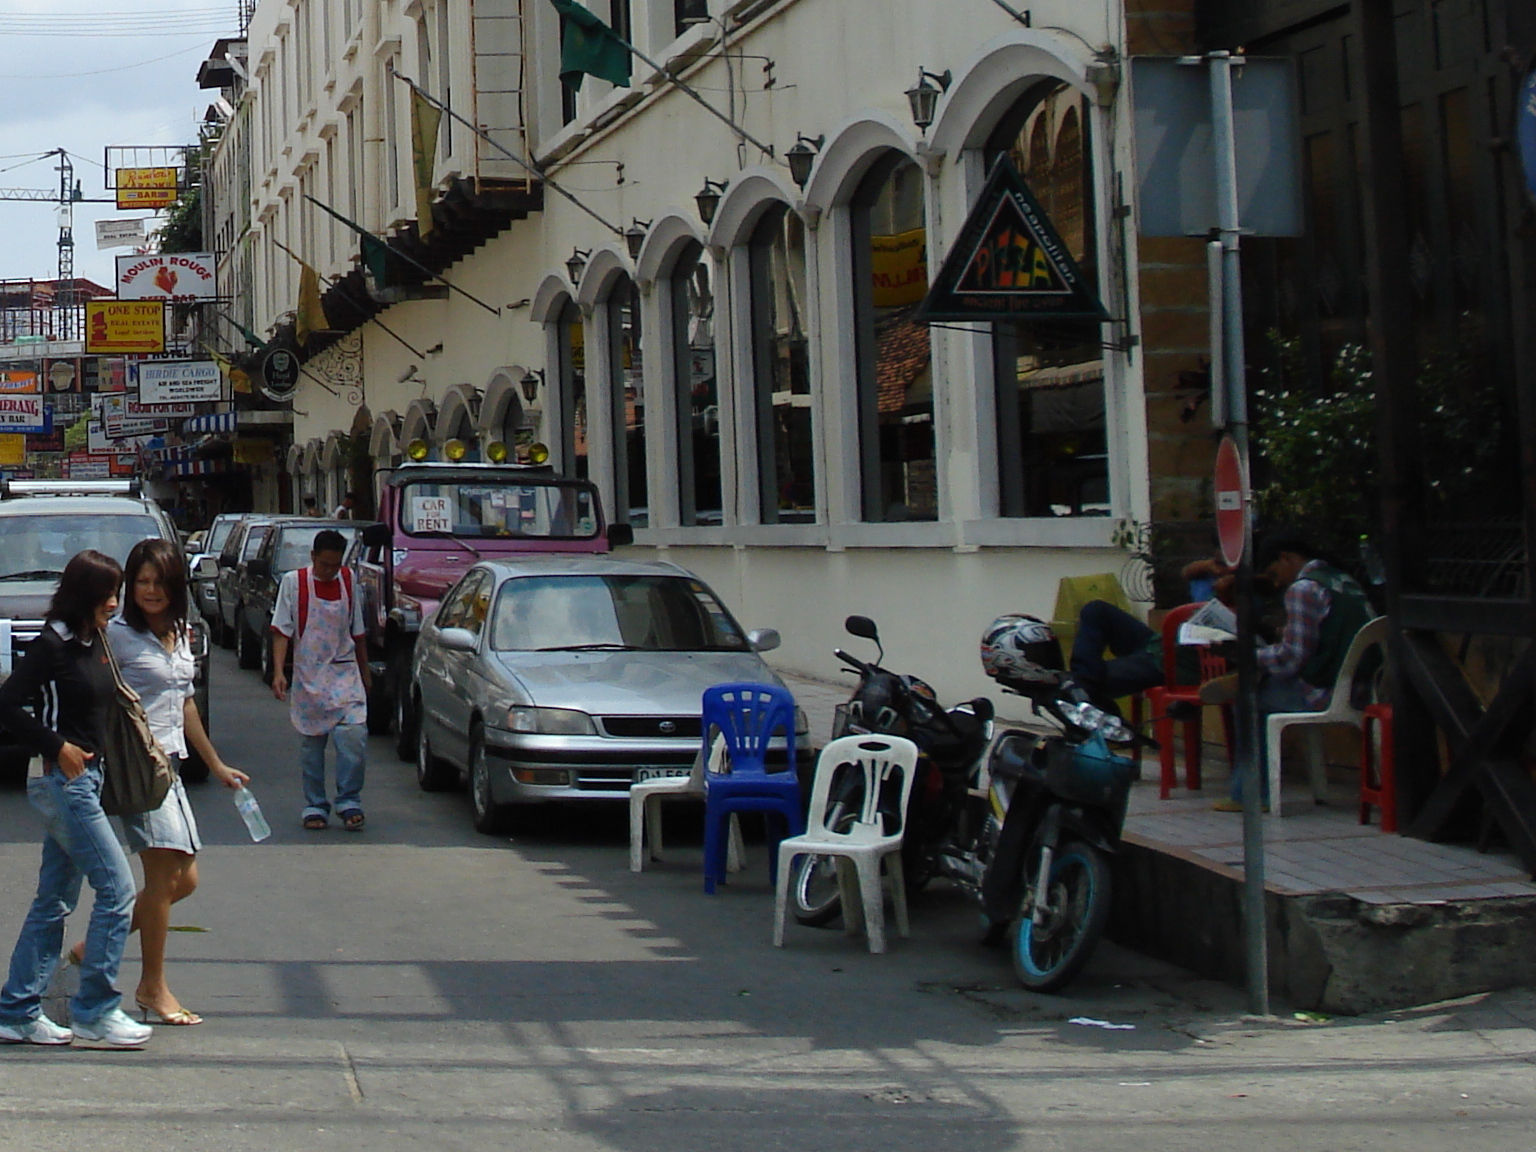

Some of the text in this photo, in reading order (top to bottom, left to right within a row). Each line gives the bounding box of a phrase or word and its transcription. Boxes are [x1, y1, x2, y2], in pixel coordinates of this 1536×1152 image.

[1014, 191, 1077, 285] neapolitan
[120, 256, 213, 285] MOULIN ROUGE
[172, 294, 196, 302] BAR
[108, 305, 161, 316] ONE STOP
[145, 369, 179, 380] BIRDIE
[182, 368, 216, 378] CARGO
[422, 499, 445, 511] CAR
[426, 511, 441, 519] FOR
[417, 518, 449, 531] RENT
